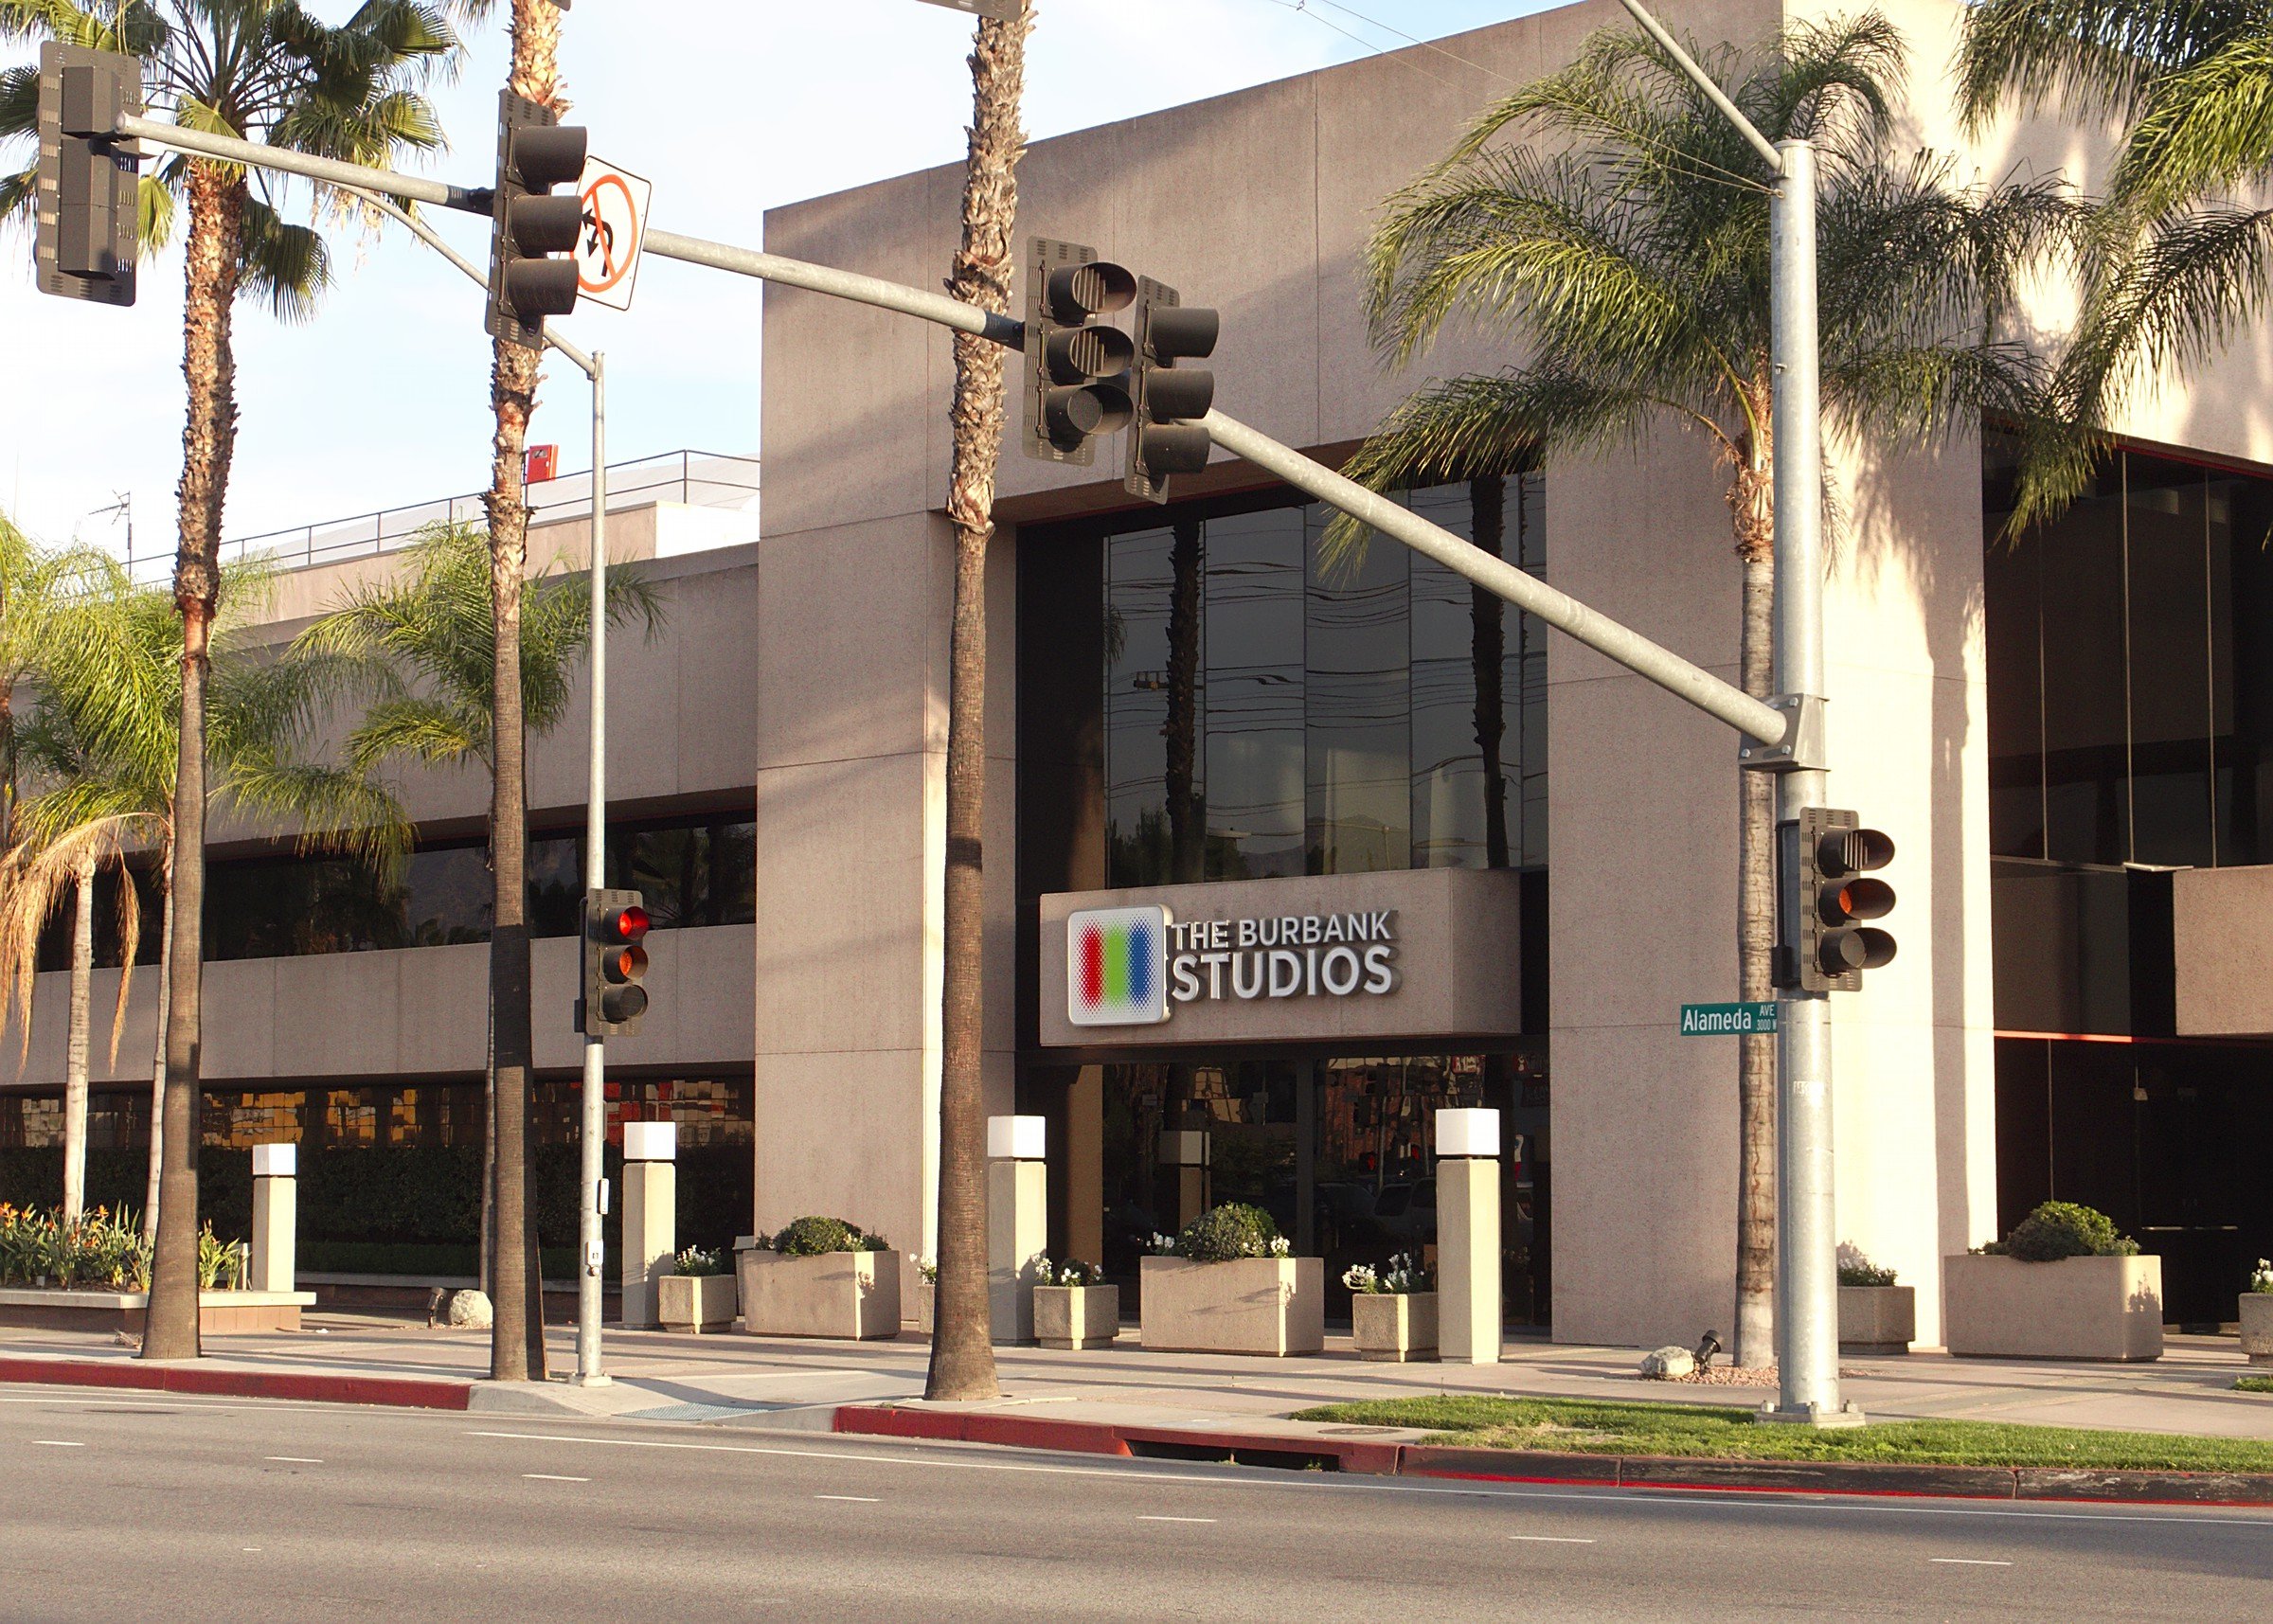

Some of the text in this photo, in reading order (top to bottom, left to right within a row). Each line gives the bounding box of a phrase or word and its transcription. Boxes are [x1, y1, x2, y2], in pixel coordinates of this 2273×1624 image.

[1171, 909, 1392, 951] THE BURBANK
[1172, 944, 1392, 1002] STUDIOS
[1683, 1008, 1751, 1031] Alameda
[1759, 1004, 1775, 1016] AVE
[1757, 1018, 1771, 1030] 3000
